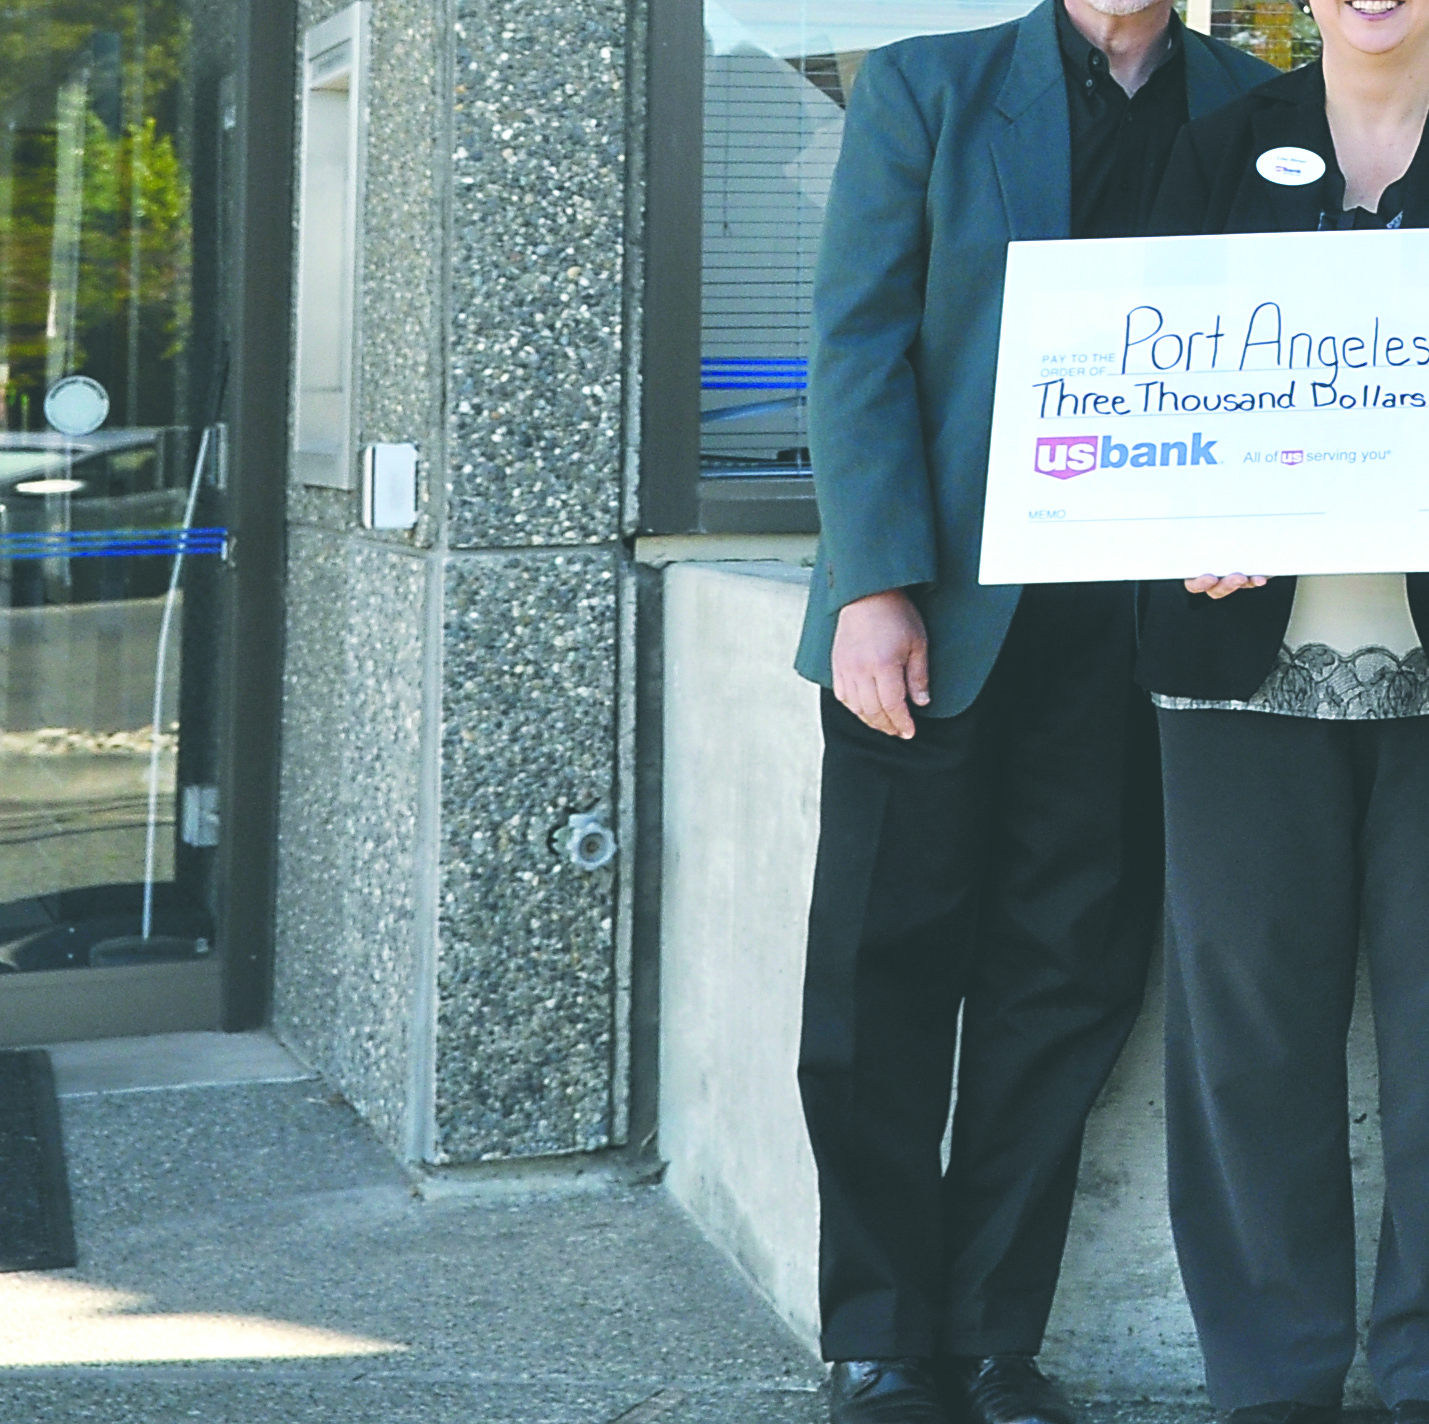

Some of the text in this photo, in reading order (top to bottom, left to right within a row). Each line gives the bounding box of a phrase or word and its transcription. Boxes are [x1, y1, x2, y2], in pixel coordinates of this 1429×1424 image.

[1122, 306, 1225, 375] Port
[1041, 352, 1116, 364] PAY TO THE
[1040, 366, 1106, 378] ORDER OF
[1032, 378, 1131, 419] Three
[1134, 380, 1296, 413] Thousand
[1310, 381, 1427, 409] Dollars
[1243, 451, 1261, 463] All
[1265, 450, 1279, 463] of
[1281, 452, 1303, 463] us
[1306, 449, 1356, 464] serving
[1028, 509, 1066, 519] MEMO
